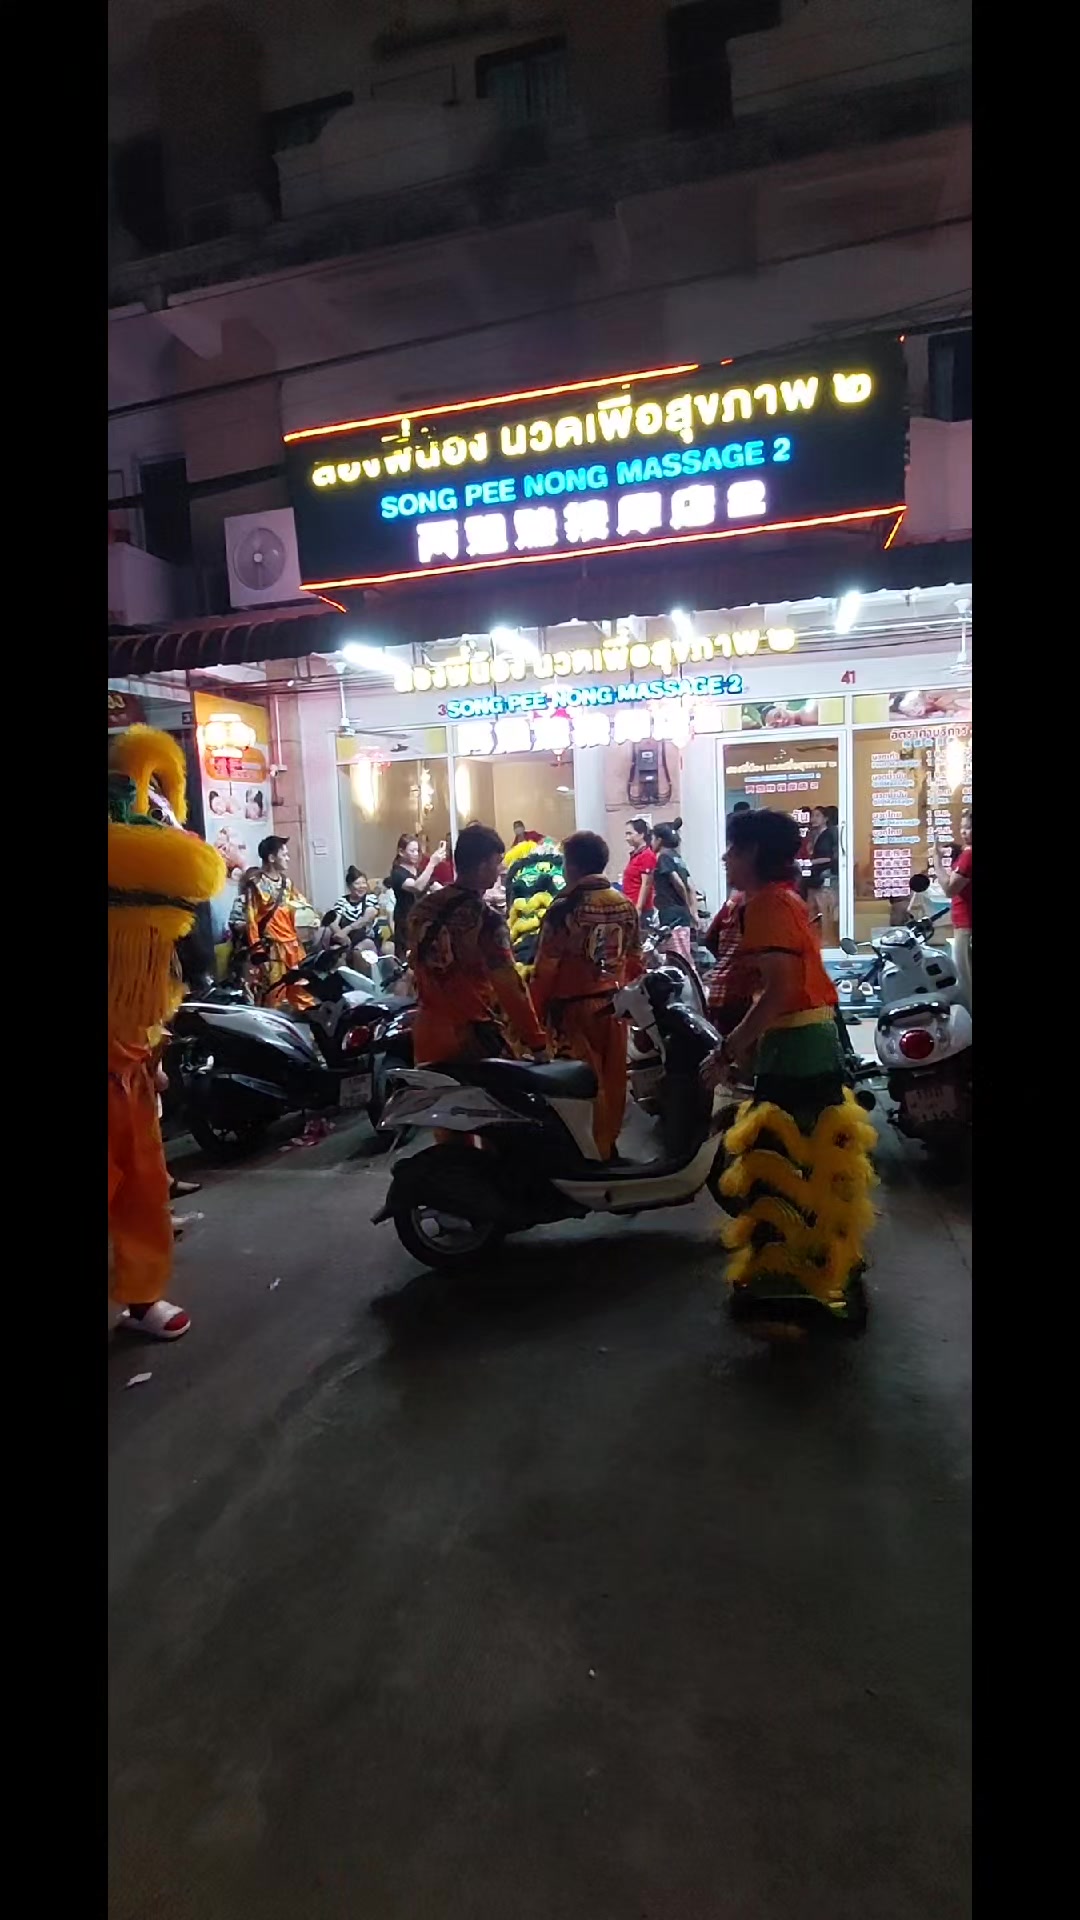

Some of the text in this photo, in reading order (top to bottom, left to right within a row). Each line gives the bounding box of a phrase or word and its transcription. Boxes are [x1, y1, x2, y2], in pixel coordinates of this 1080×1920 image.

[500, 384, 819, 457] นวดเพื่อสุขภาพ
[833, 372, 873, 404] ๒
[381, 436, 791, 519] SONG PEE NONG MASSAGE 2
[446, 673, 743, 719] SONG PEE NONG MASSAGE 2
[841, 670, 856, 685] 41
